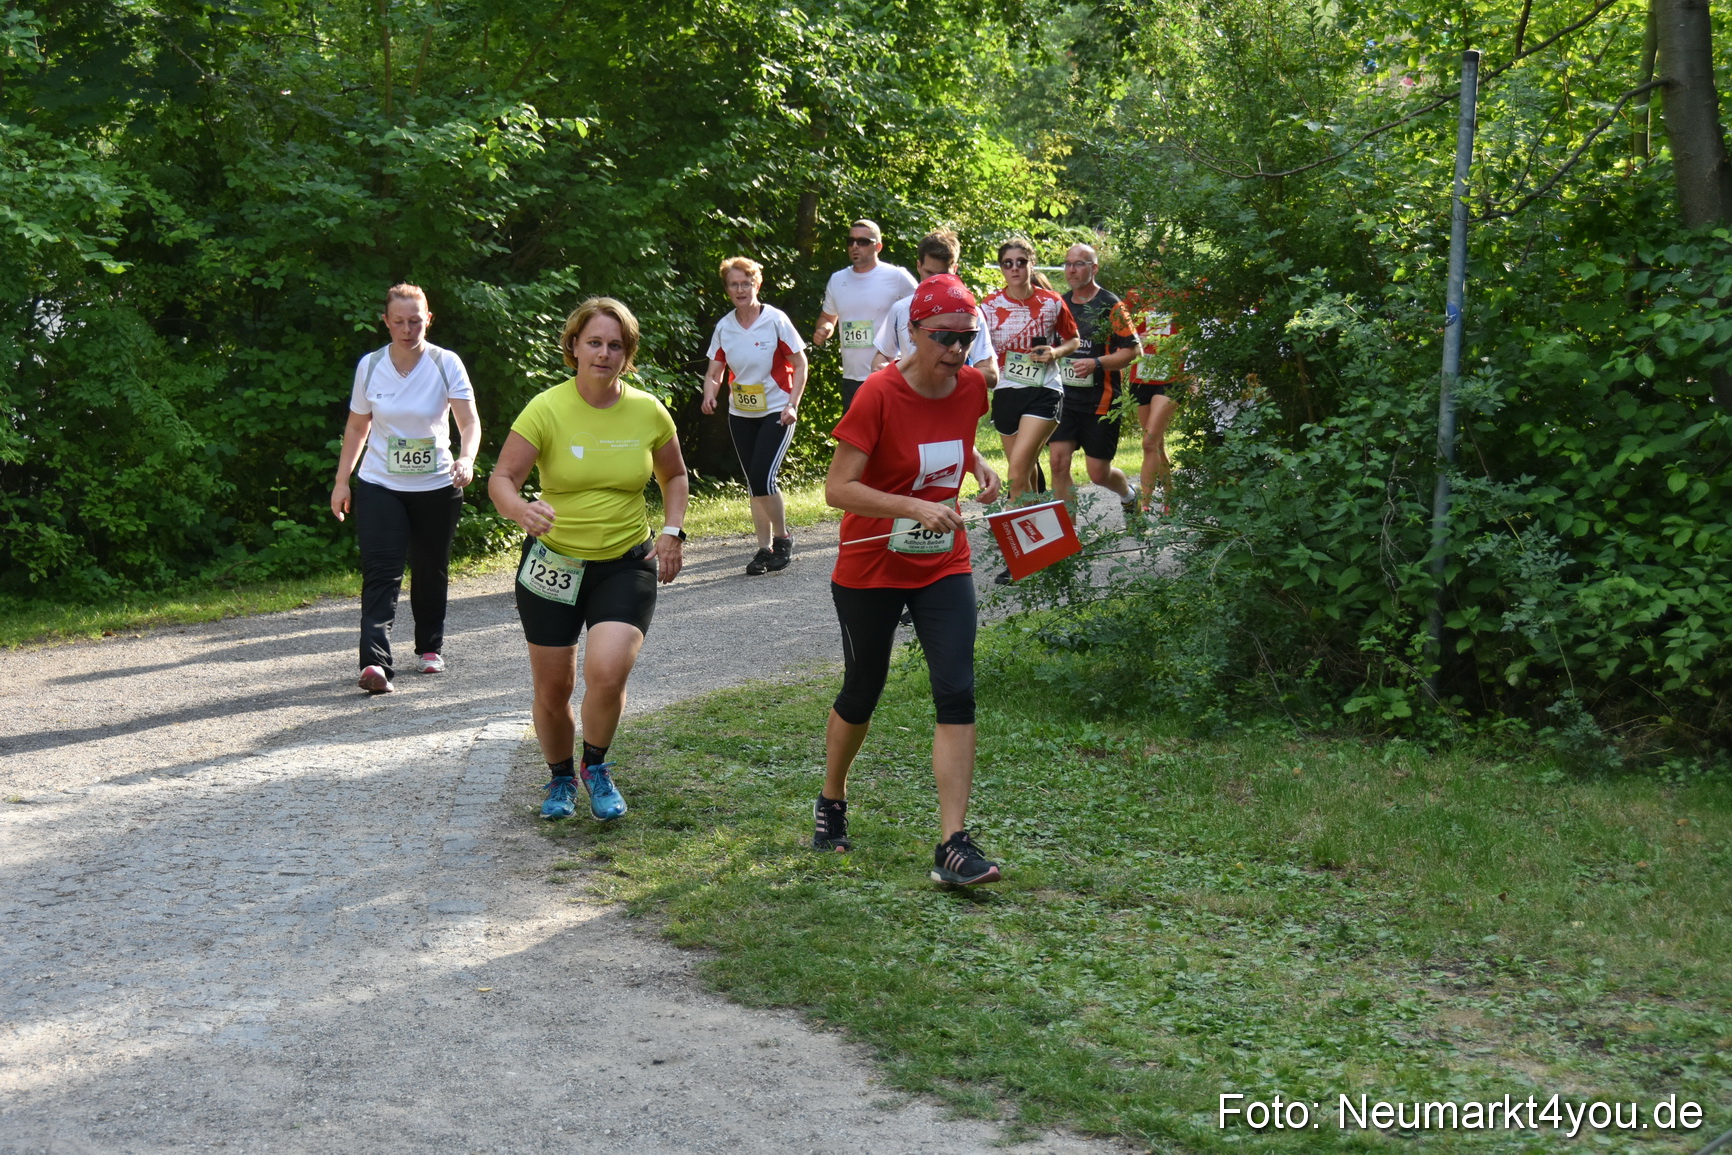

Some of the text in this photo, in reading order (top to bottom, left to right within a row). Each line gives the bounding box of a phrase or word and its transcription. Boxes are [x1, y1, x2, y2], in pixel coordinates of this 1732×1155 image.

[845, 330, 867, 340] 2161
[1008, 363, 1040, 378] 2217
[738, 393, 757, 404] 366
[394, 451, 431, 464] 1465
[529, 559, 572, 589] 1233
